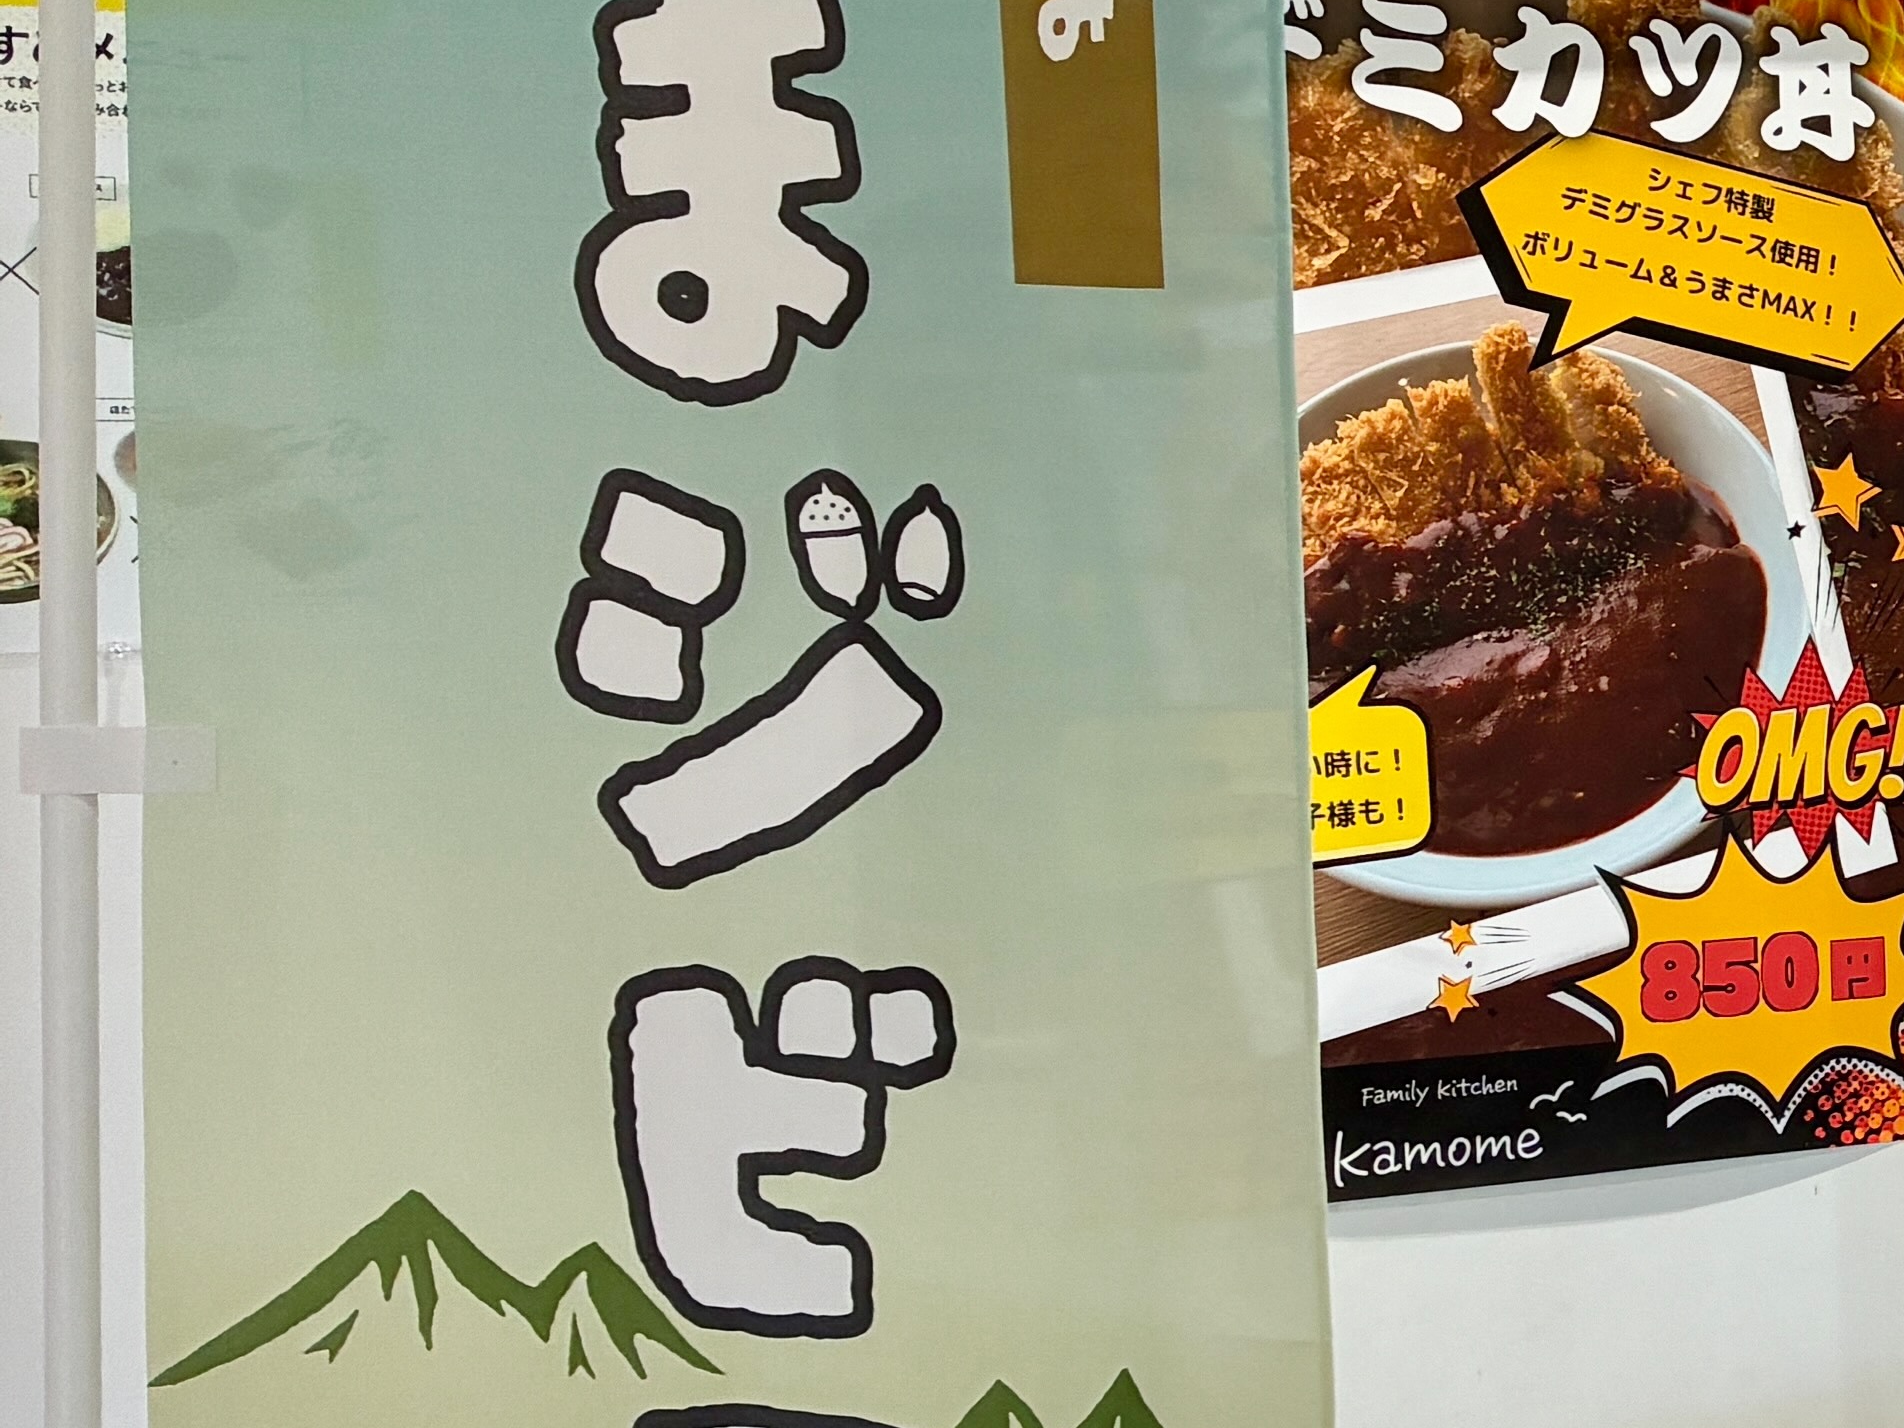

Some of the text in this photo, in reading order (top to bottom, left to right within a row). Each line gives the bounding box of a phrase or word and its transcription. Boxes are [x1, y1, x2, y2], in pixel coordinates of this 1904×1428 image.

[1561, 186, 1840, 277] デミグラスソース使用！
[1648, 167, 1776, 225] シェフ特製
[1521, 229, 1860, 334] ボリューム＆うまさMAX！！
[1638, 931, 1887, 1022] 850円
[1361, 1074, 1519, 1107] Family kitchen
[1332, 1122, 1544, 1188] kamome
